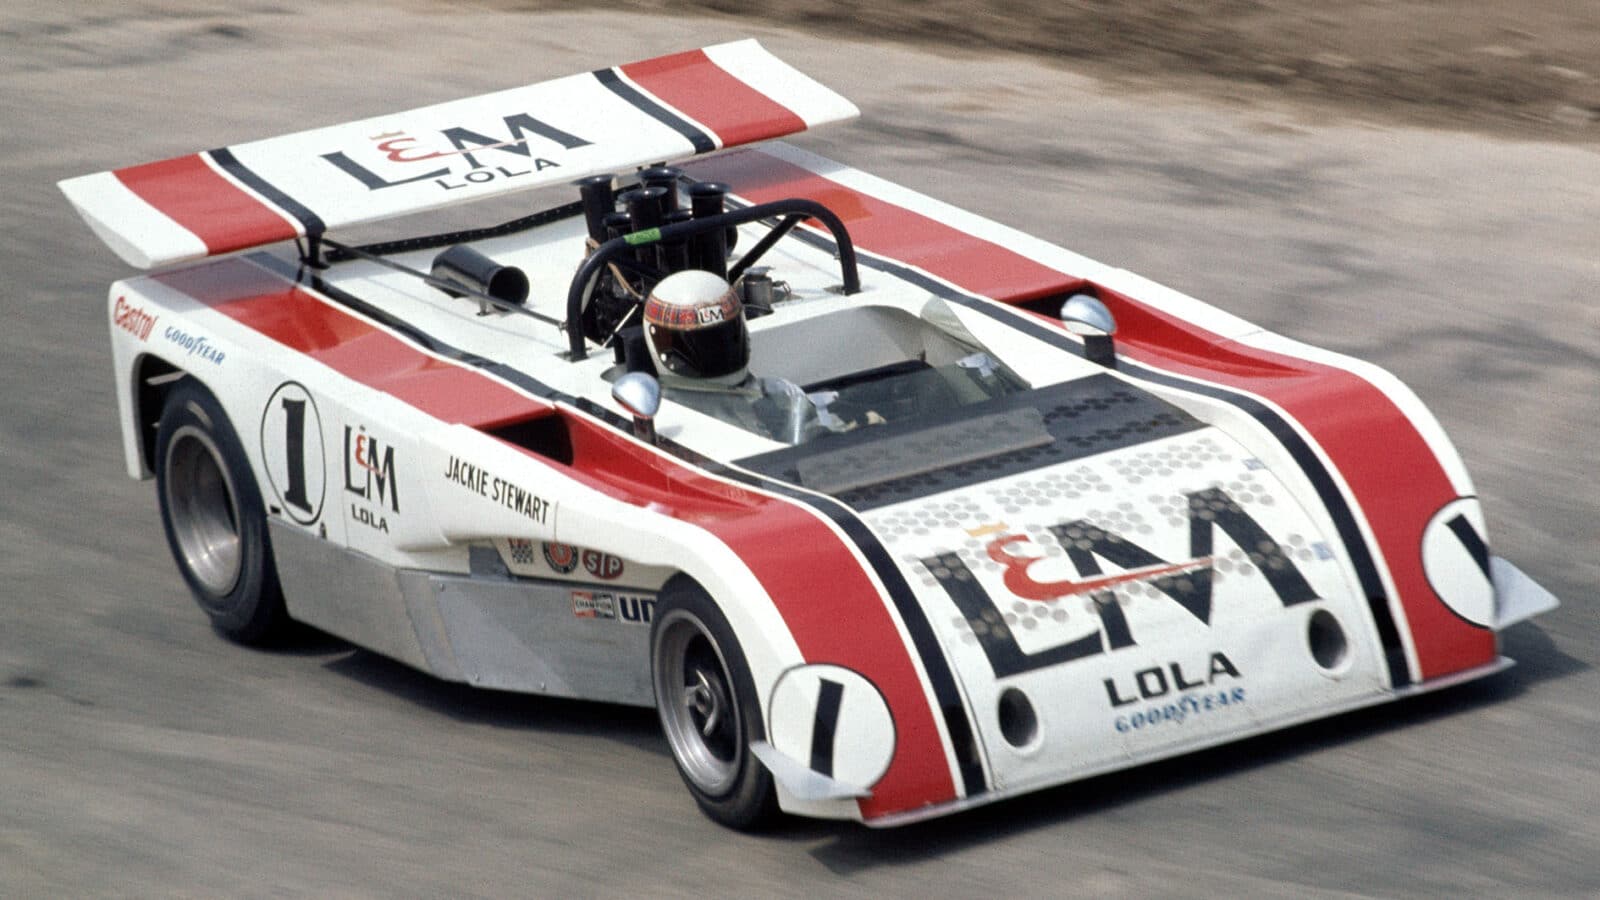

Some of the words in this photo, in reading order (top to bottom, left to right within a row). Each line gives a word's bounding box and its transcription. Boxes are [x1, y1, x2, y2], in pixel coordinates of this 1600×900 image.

[435, 157, 561, 190] LOLA
[114, 295, 159, 342] Castrol
[165, 325, 225, 366] GOODYEAR
[282, 397, 313, 515] 1
[445, 454, 489, 497] JACKIE
[491, 476, 550, 525] STEWART
[351, 503, 390, 534] LOLA
[1103, 651, 1242, 708] LOLA
[809, 675, 845, 781] 1
[1114, 686, 1246, 733] GOODYEAR
